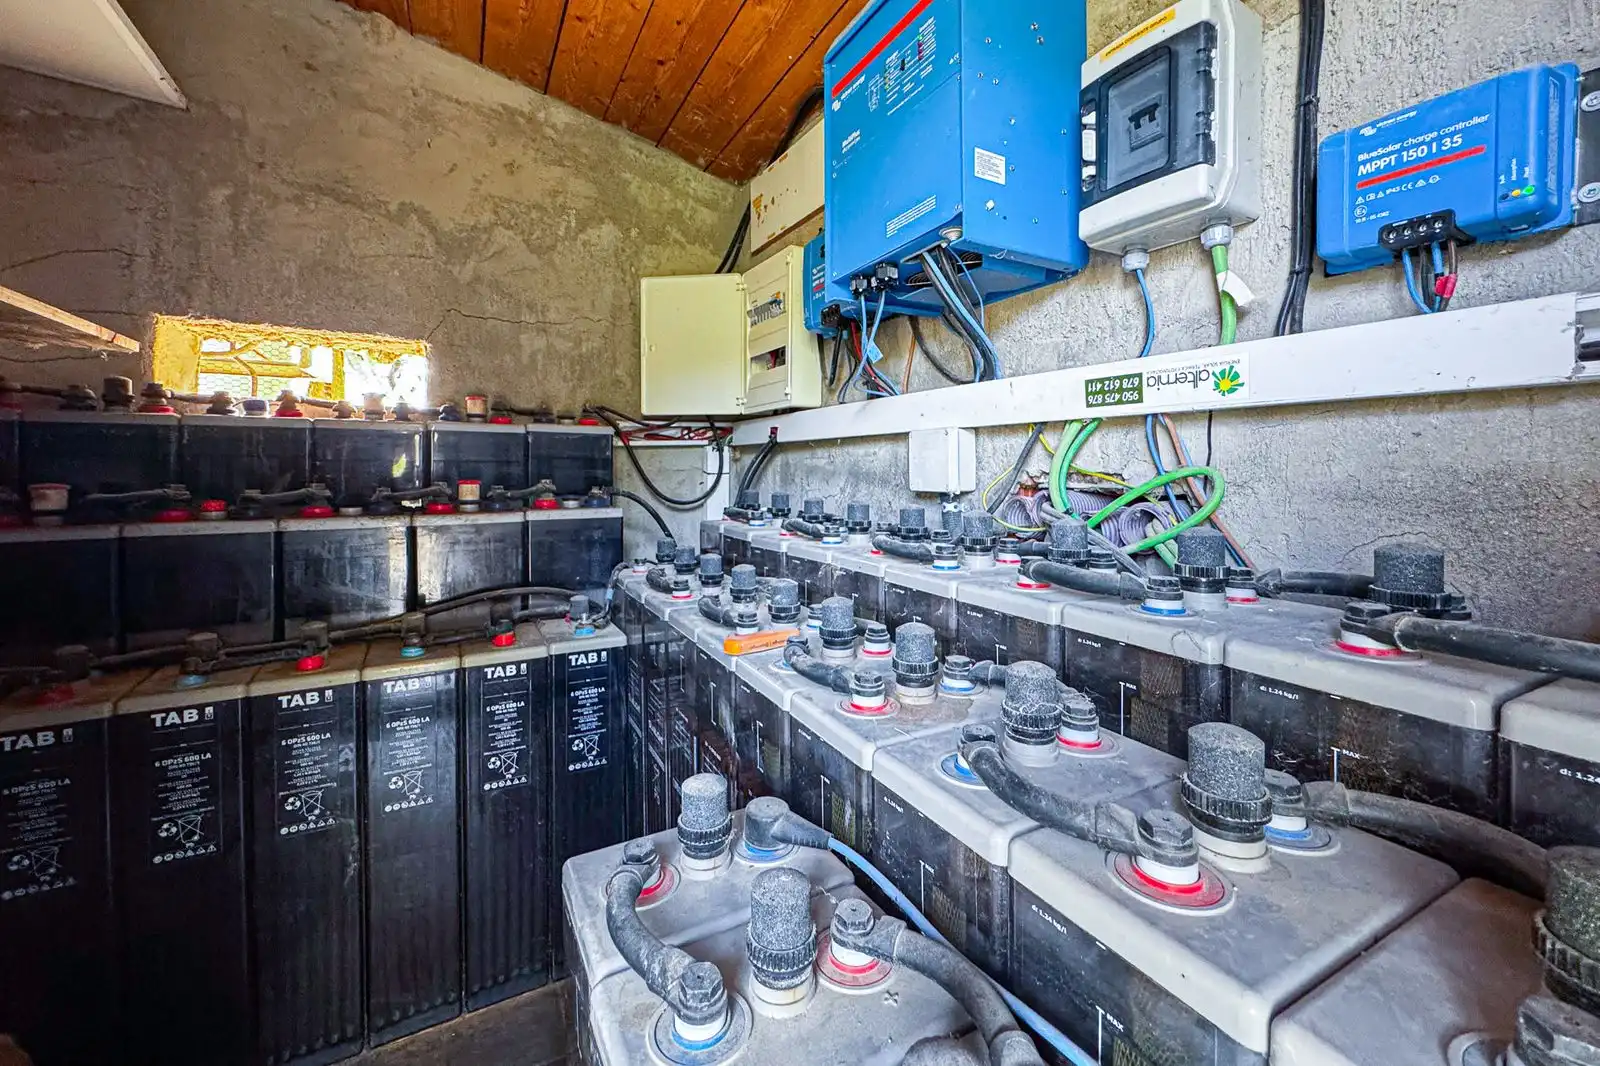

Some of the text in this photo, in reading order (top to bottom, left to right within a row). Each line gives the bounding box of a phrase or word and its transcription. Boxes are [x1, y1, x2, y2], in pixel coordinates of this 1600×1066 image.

[1357, 114, 1490, 162] BlueSolar charge controller
[1357, 153, 1399, 177] MPPT
[1401, 145, 1428, 163] 150
[1441, 133, 1463, 151] 35
[1087, 376, 1140, 393] 678 612 411
[1087, 390, 1139, 405] 950 475 876
[568, 652, 598, 666] TAB
[484, 664, 517, 679] TAB
[383, 678, 421, 694] TAB
[1268, 687, 1283, 696] 1.24
[1283, 691, 1299, 700] kg/l
[277, 691, 320, 709] TAB
[150, 708, 200, 728] TAB
[391, 719, 408, 728] OPzS
[408, 717, 421, 725] 600
[0, 730, 55, 752] TAB
[287, 736, 306, 745] OPzS
[306, 734, 320, 742] 600
[321, 732, 331, 740] LA
[161, 757, 183, 767] OPzS
[184, 754, 200, 762] 600
[201, 752, 212, 760] LA
[1342, 749, 1360, 760] MAX
[1559, 768, 1572, 777] d:
[57, 778, 71, 786] LA
[1039, 909, 1053, 924] 1.24
[1053, 919, 1067, 935] kg/l
[1106, 1012, 1124, 1033] MAX
